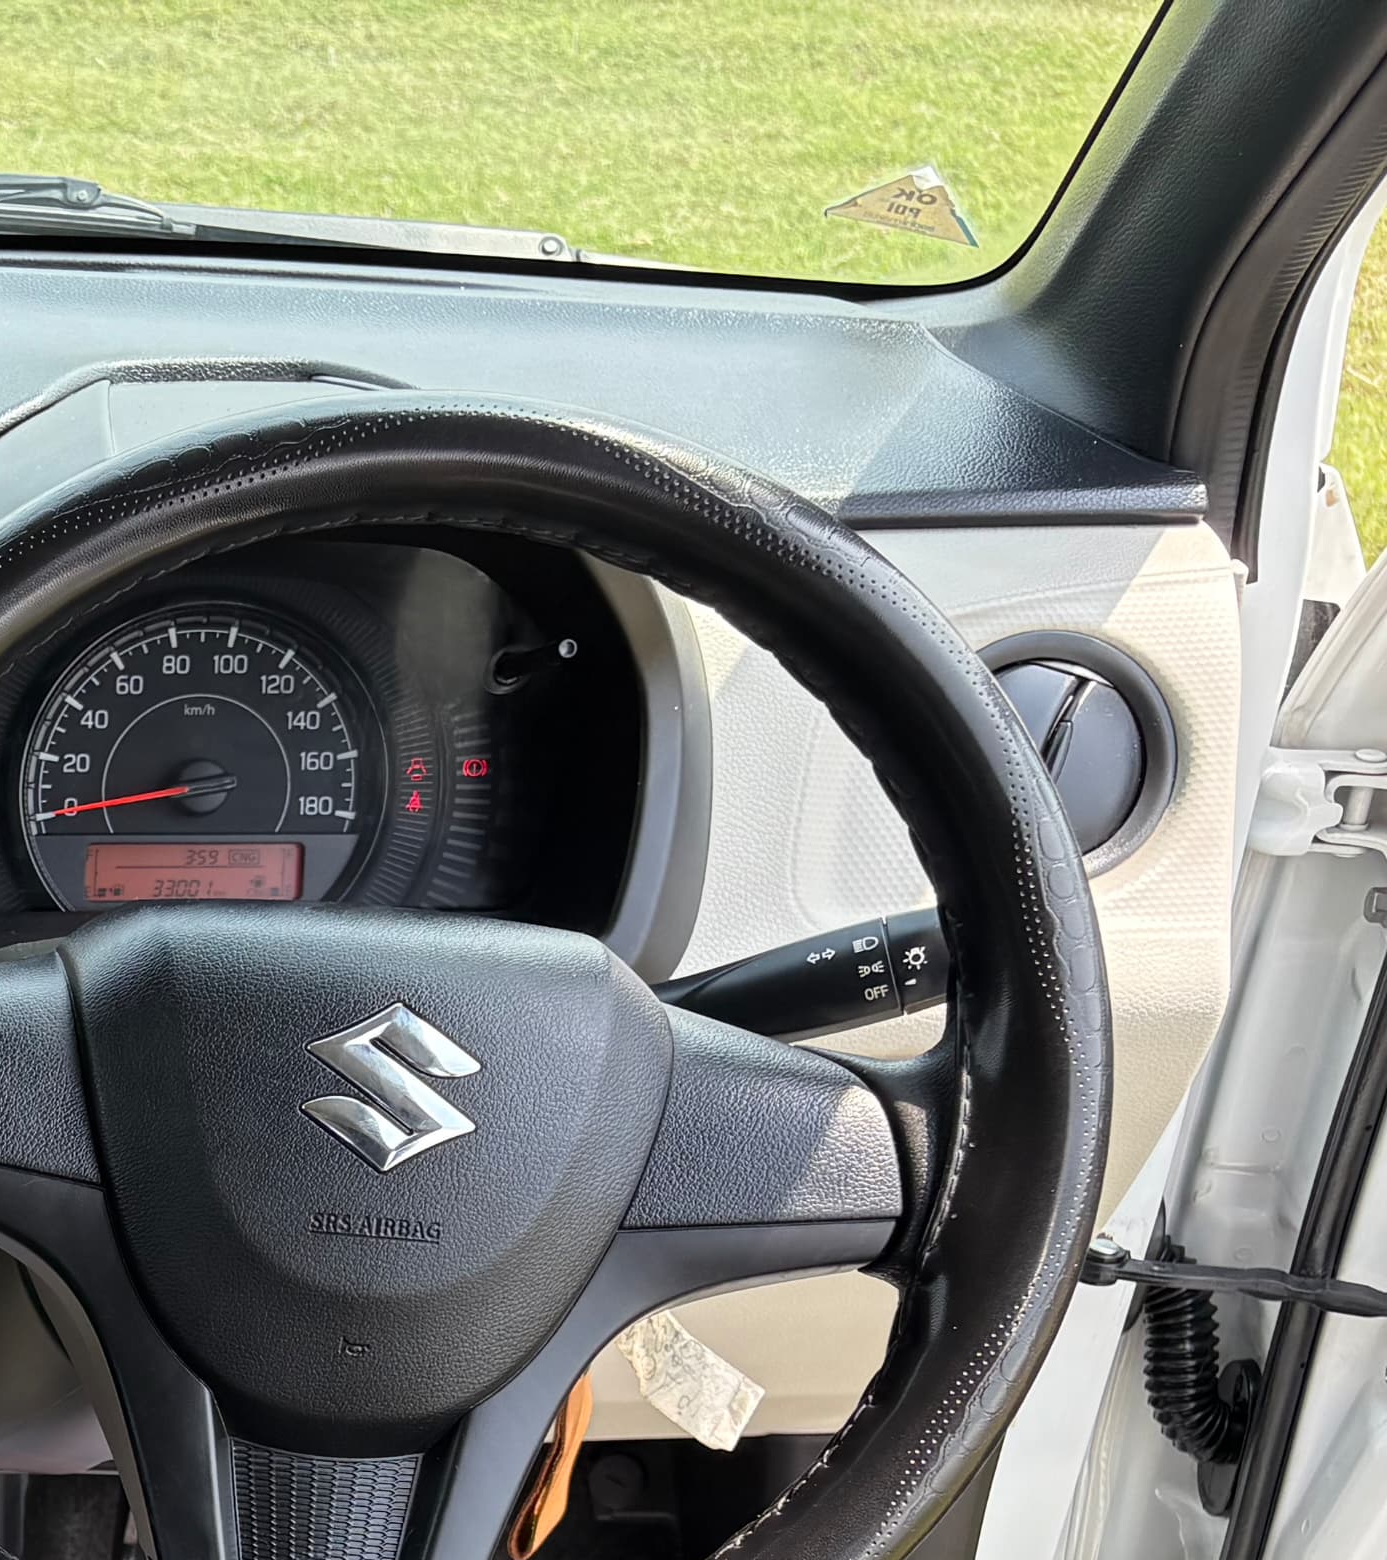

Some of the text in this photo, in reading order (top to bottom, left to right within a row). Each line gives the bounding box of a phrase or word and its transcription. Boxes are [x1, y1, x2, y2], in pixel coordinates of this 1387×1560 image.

[162, 654, 191, 676] 80
[212, 654, 249, 676] 100
[115, 674, 144, 696] 60
[260, 674, 295, 695] 120
[80, 709, 110, 731] 40
[183, 702, 216, 719] km/h
[286, 710, 321, 731] 140
[62, 752, 91, 774] 20
[299, 751, 335, 772] 160
[298, 795, 334, 817] 180
[863, 984, 890, 1001] OFF
[309, 1212, 442, 1241] SRS AIRBAG
